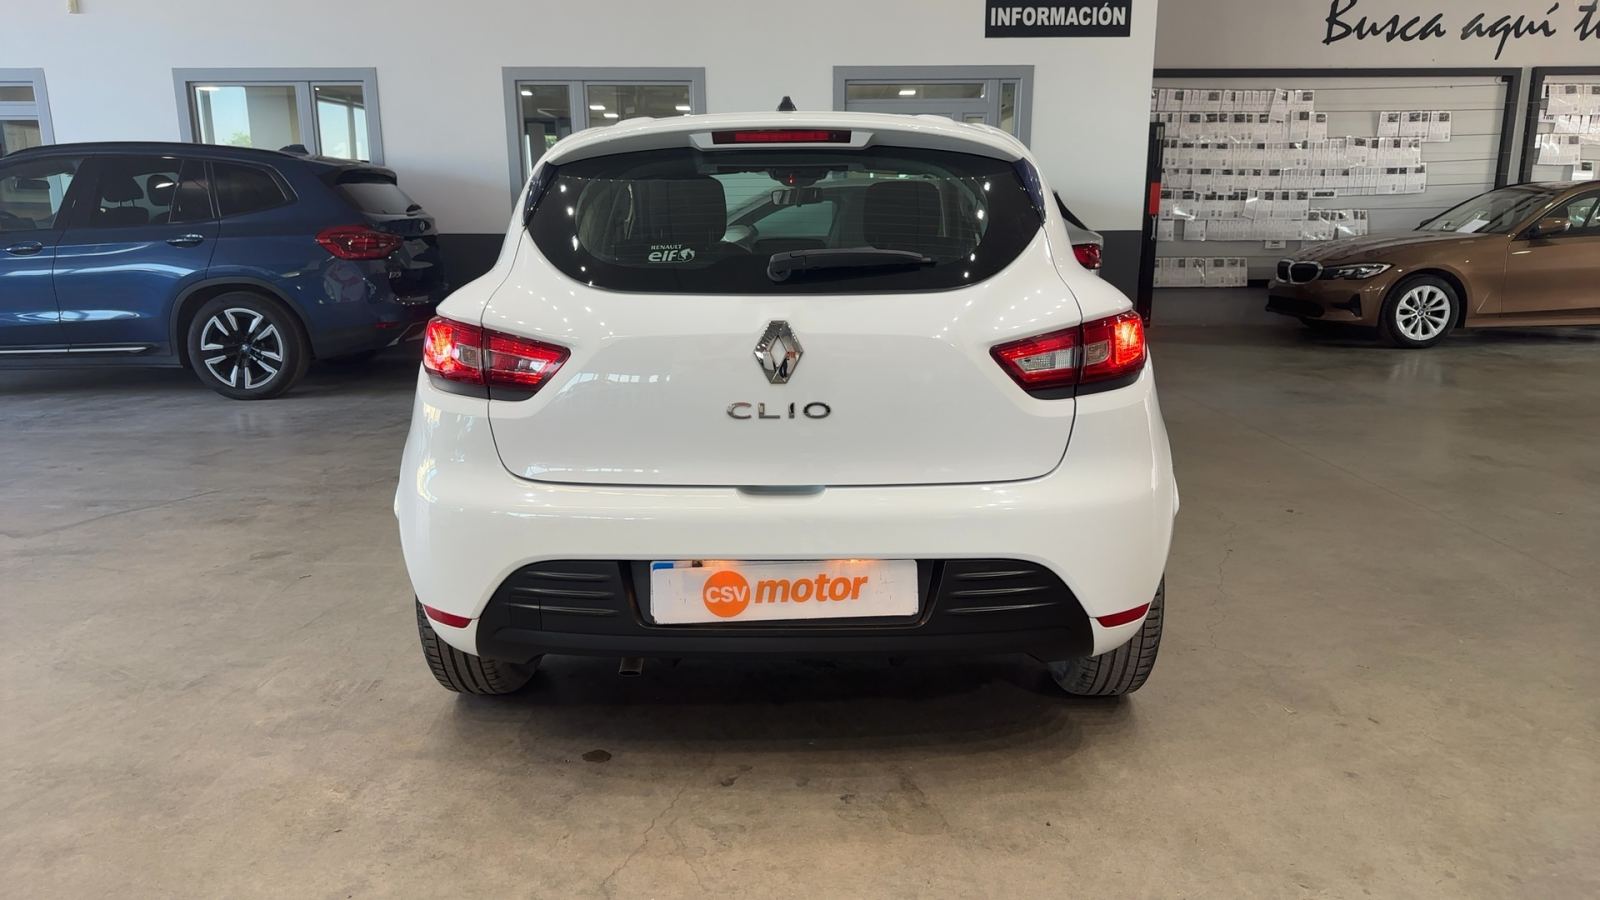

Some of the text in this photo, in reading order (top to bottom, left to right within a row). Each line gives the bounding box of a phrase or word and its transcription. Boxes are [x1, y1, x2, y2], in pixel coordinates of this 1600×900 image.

[990, 2, 1126, 26] INFORMACIÓN
[1322, 0, 1446, 45] Busca
[1460, 2, 1560, 60] aquí
[648, 249, 679, 262] elf
[726, 401, 831, 420] CLIO
[705, 573, 868, 604] CSV motor
